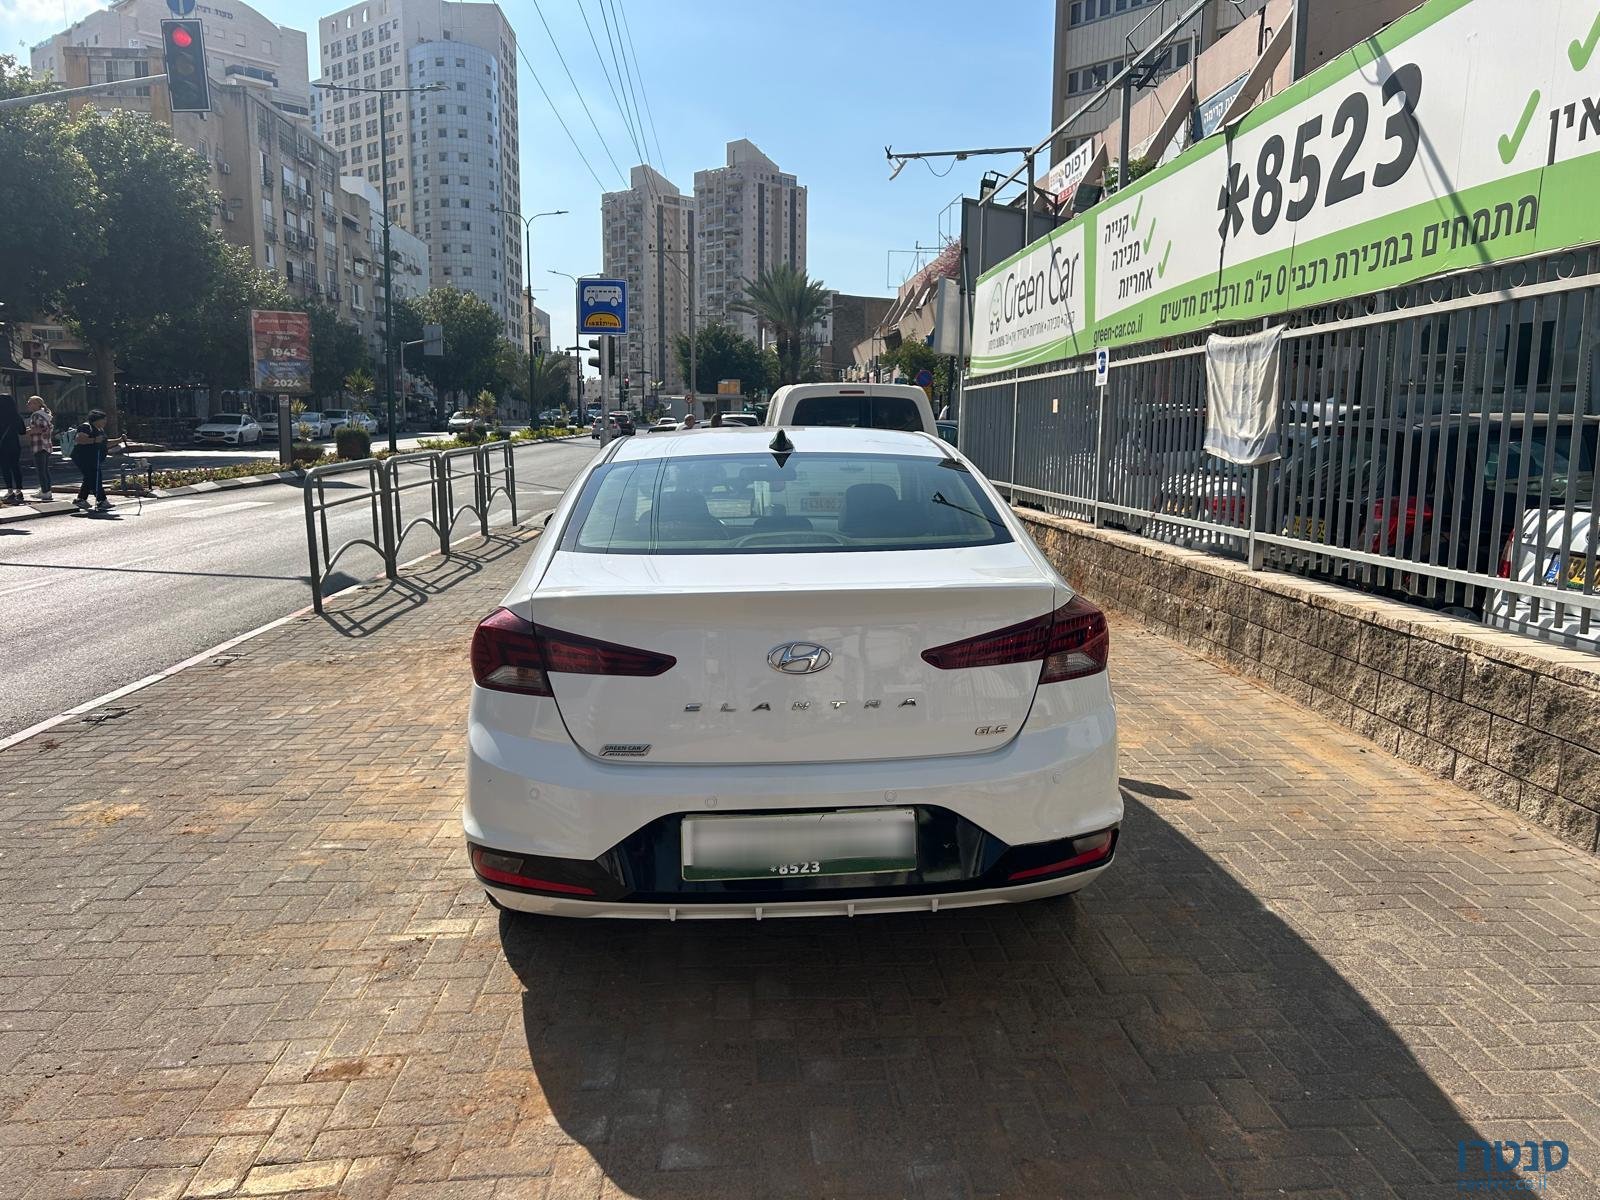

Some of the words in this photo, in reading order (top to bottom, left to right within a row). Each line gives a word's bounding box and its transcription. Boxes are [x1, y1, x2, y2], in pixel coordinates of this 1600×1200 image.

[1065, 148, 1087, 179] דפוס
[1104, 214, 1130, 245] קנייה
[1422, 194, 1538, 257] מתמחים
[1112, 240, 1140, 271] מכירה
[1333, 232, 1413, 281] במכירת
[1004, 272, 1045, 323] Green
[1048, 246, 1079, 305] Car
[1118, 267, 1154, 300] אחריות
[1276, 264, 1287, 295] 0
[1291, 257, 1329, 291] רכבי
[1160, 295, 1197, 324] חדשים
[1200, 282, 1241, 315] ורכבים
[1093, 312, 1144, 346] green-car.co.il
[271, 348, 297, 357] 1945
[273, 379, 301, 388] 2024
[684, 697, 917, 712] ELANTRA
